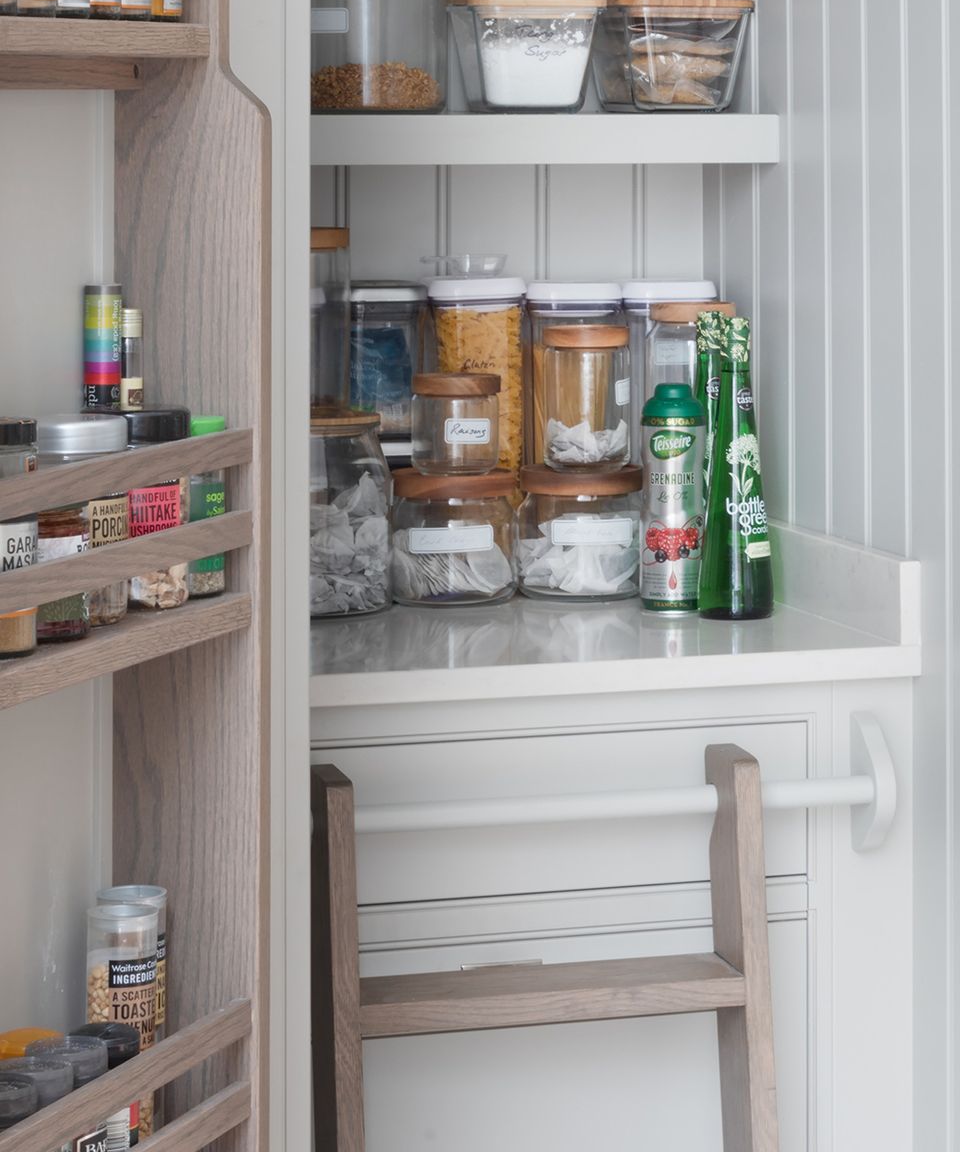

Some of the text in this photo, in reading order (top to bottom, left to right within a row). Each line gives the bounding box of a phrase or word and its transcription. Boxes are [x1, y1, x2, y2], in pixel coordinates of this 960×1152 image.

[652, 434, 692, 452] Teisseire
[650, 472, 695, 485] GRENADINE
[92, 506, 98, 517] A
[726, 495, 765, 515] bottle
[112, 962, 146, 974] Waitrose
